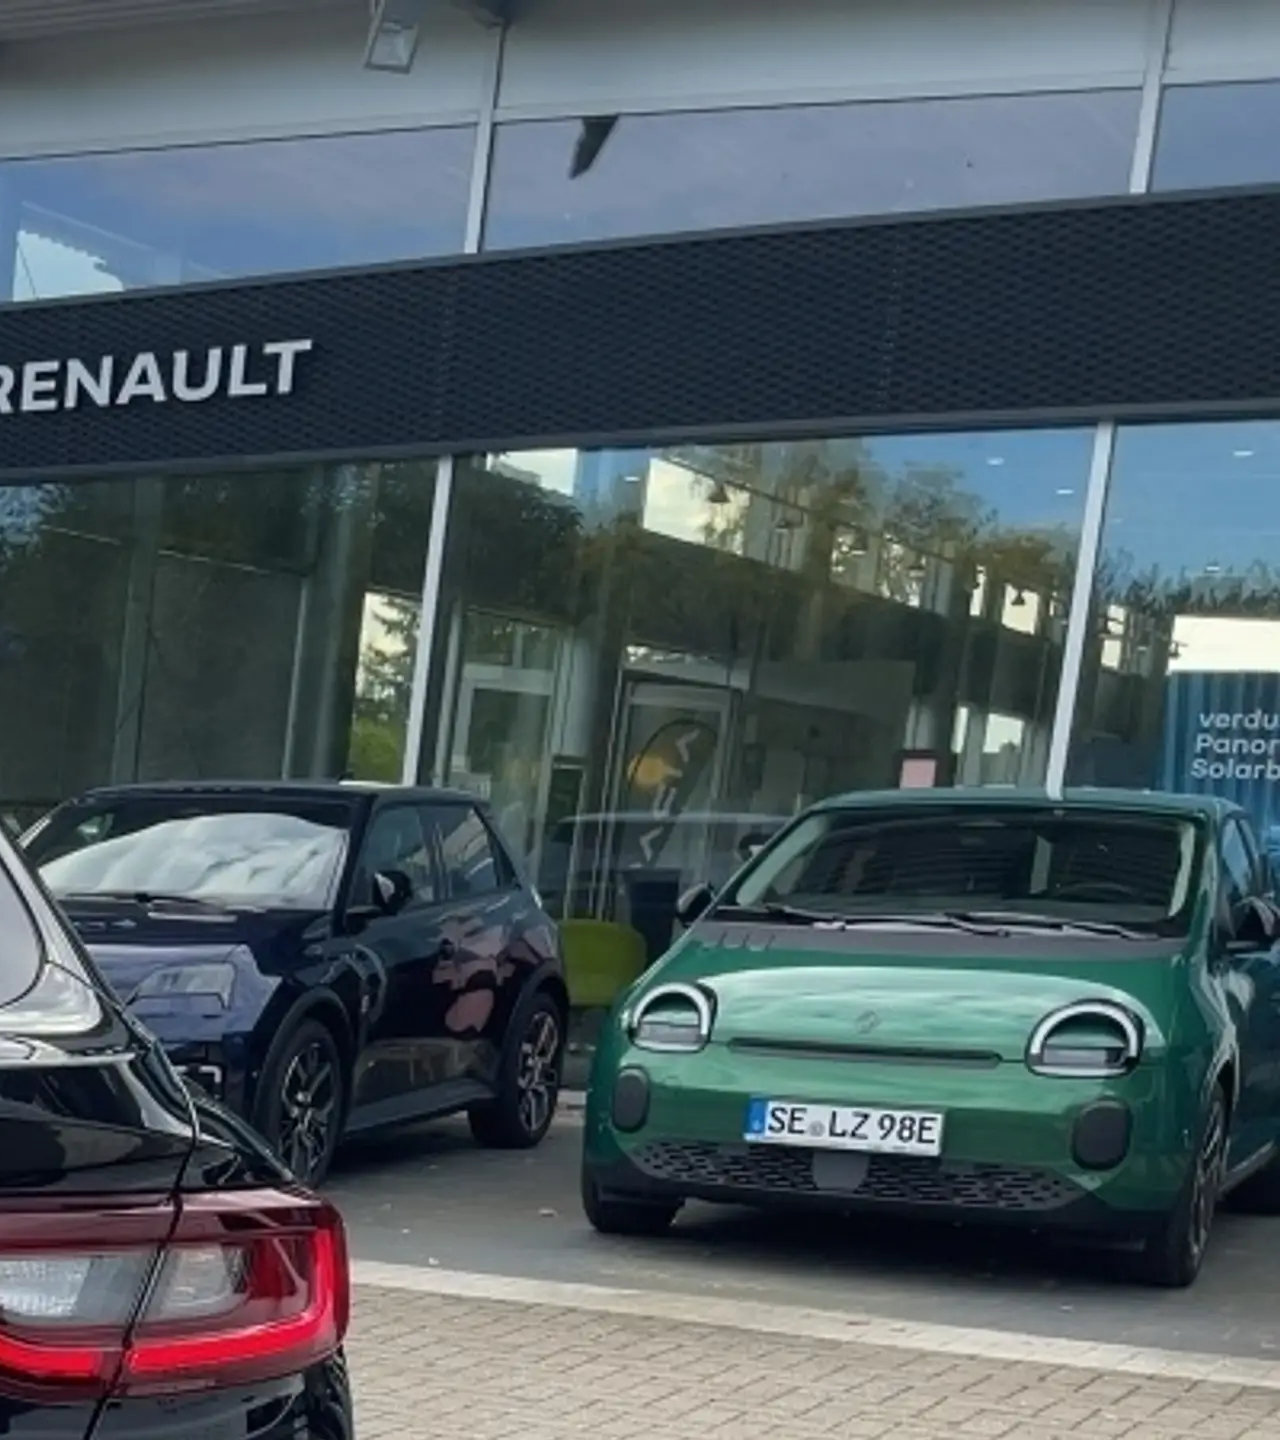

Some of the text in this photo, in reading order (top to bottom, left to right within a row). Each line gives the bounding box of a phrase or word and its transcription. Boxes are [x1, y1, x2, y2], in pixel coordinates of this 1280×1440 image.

[1199, 708, 1279, 731] verdu
[1195, 732, 1280, 755] Panor
[1190, 757, 1280, 780] Solarb
[768, 1107, 937, 1144] SE LZ 98E
